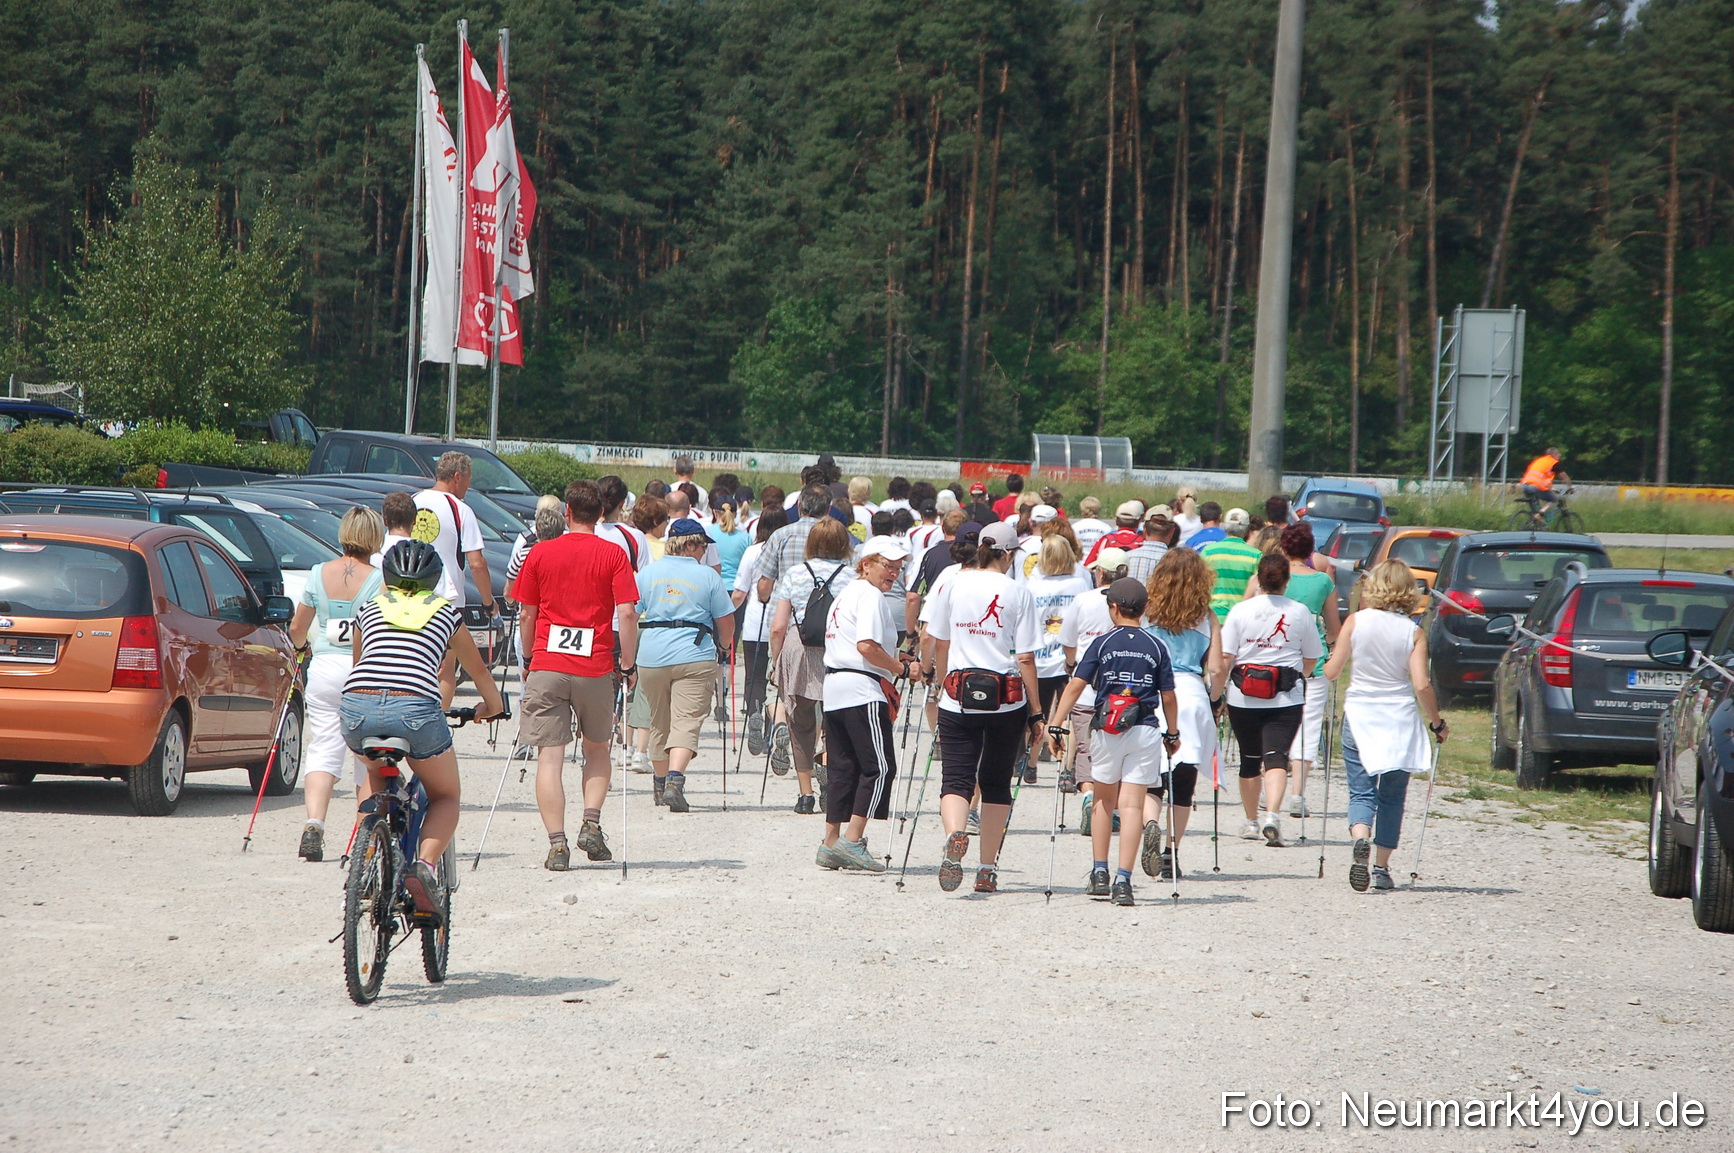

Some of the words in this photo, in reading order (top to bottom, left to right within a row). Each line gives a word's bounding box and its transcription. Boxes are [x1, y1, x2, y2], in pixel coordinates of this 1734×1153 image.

[596, 447, 644, 459] ZIMMEREI
[558, 628, 583, 651] 24
[969, 629, 997, 639] Walking
[1118, 671, 1154, 684] SLS
[1638, 672, 1657, 685] NM
[1594, 700, 1671, 710] www.gerha
